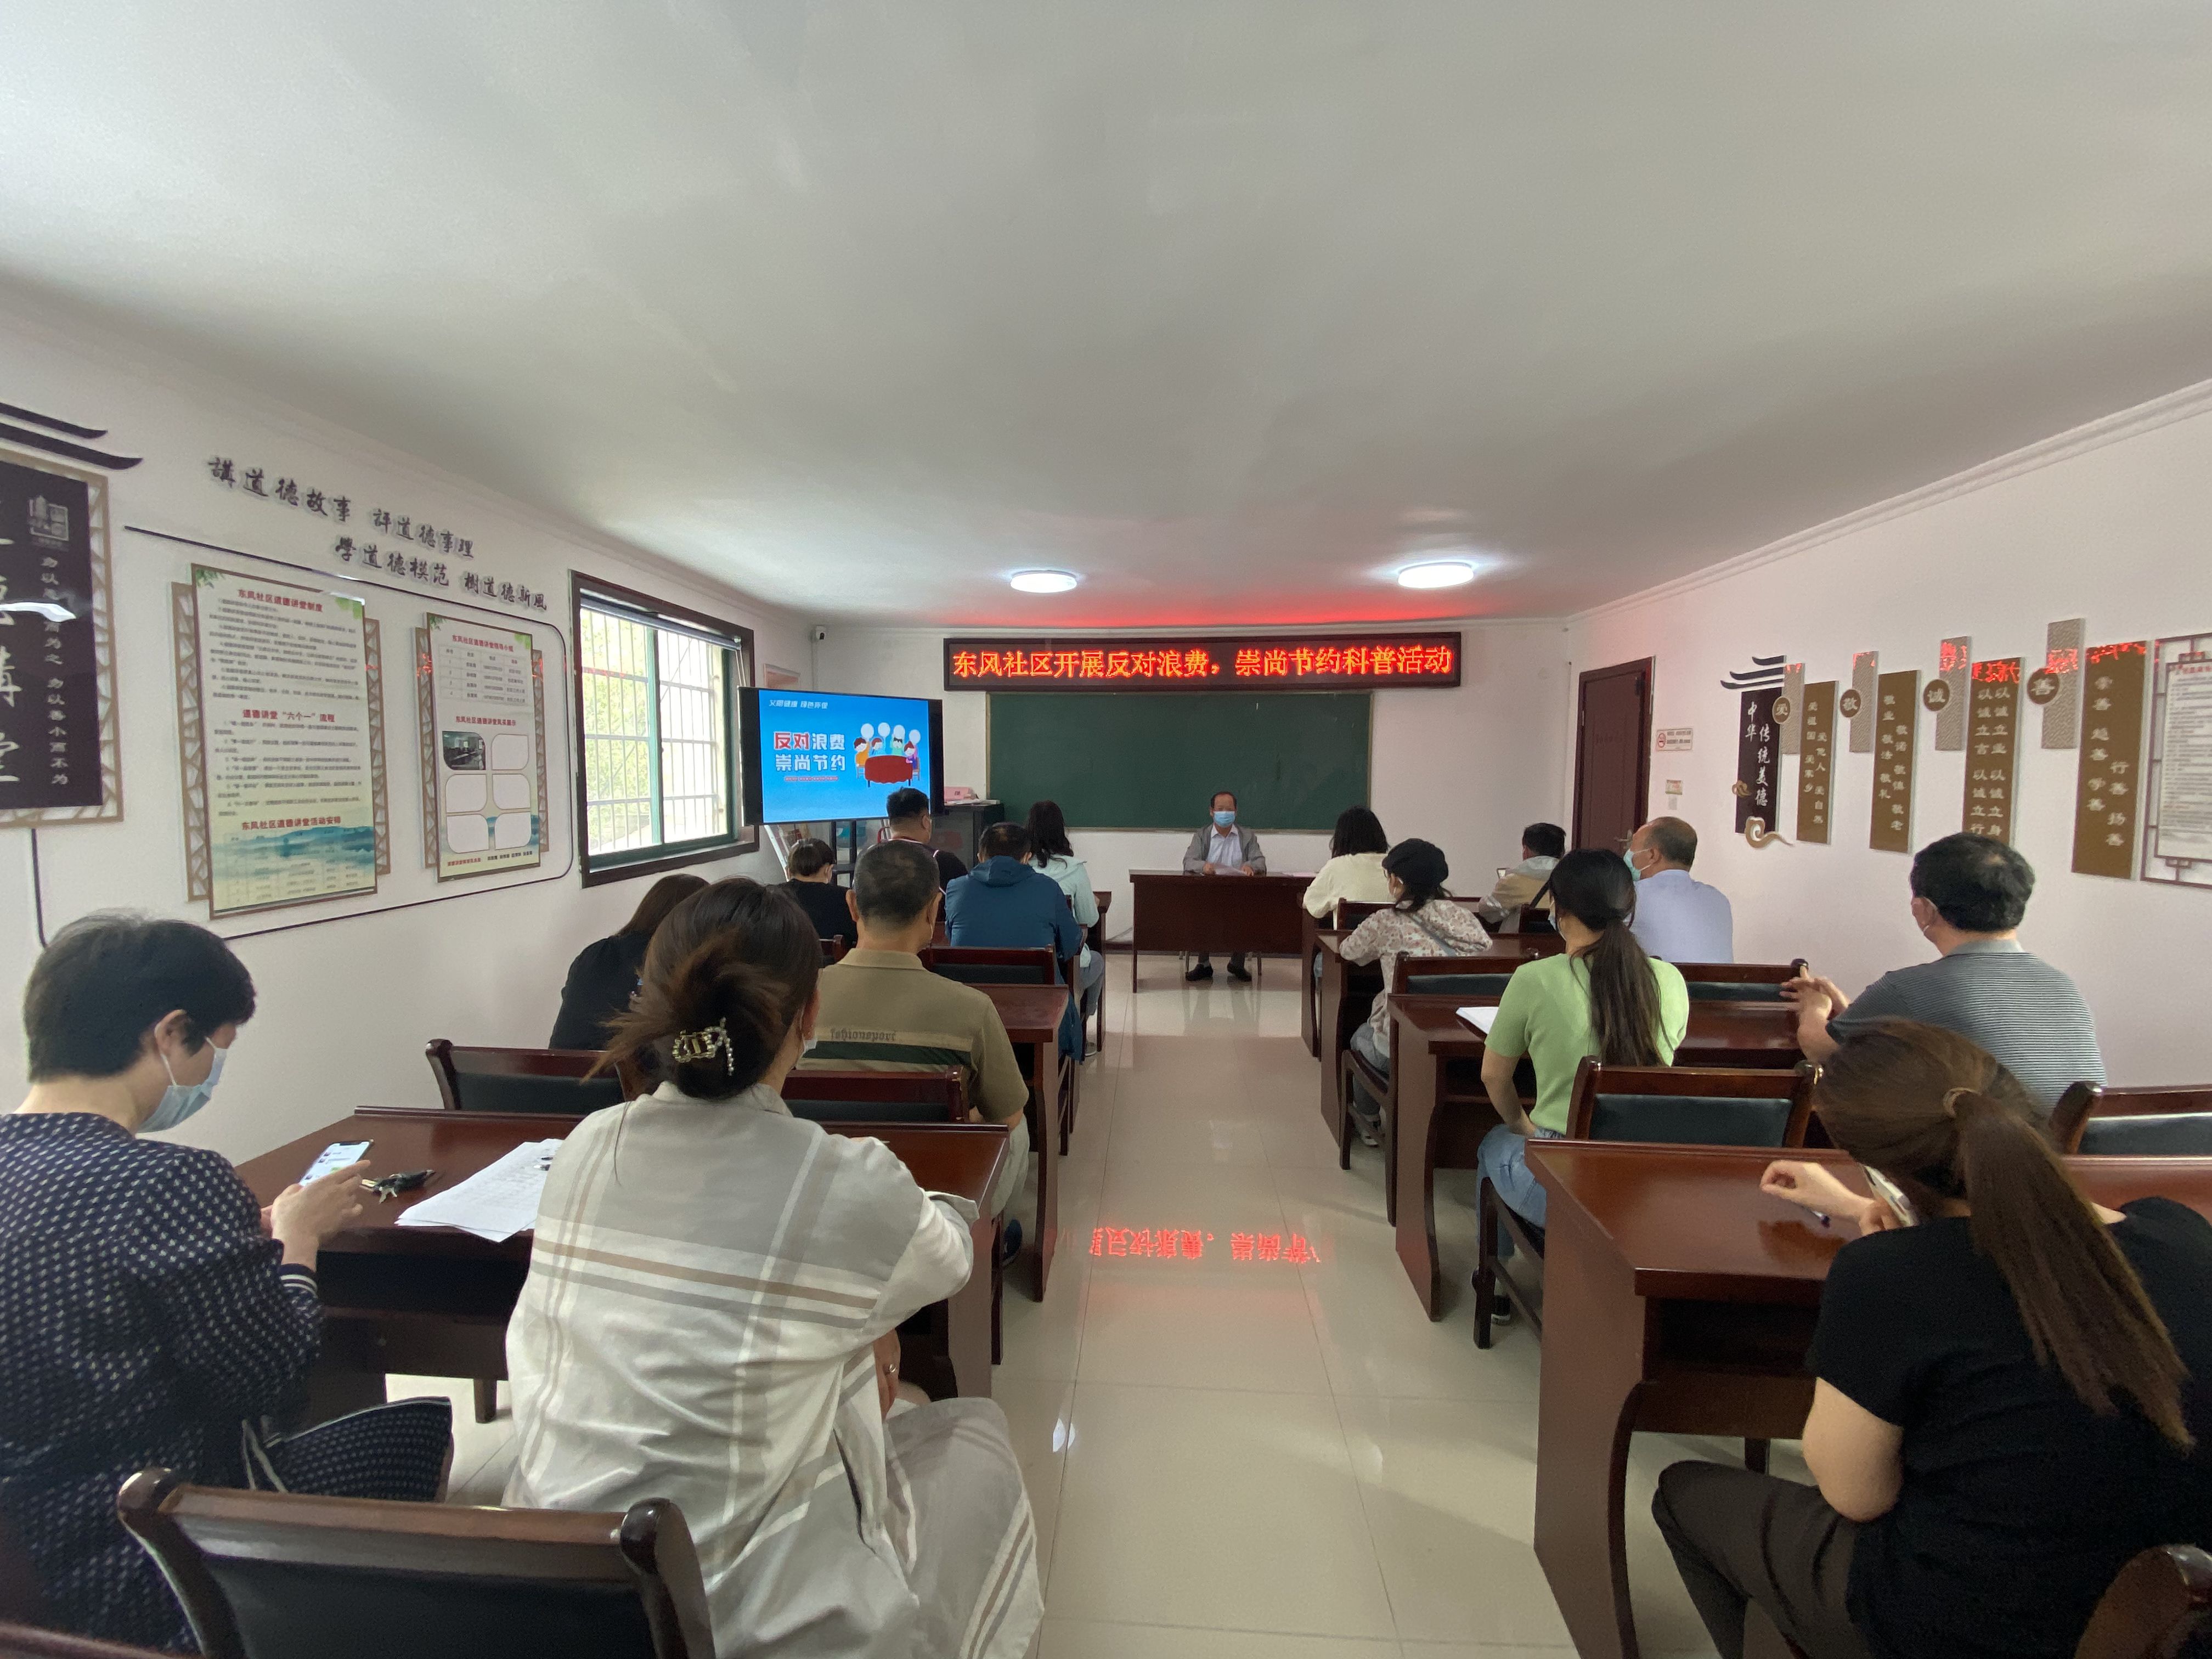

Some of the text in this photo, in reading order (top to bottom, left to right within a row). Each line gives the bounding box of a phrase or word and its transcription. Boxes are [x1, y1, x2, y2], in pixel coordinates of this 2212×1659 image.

[1745, 701, 1758, 742] 中华
[774, 731, 845, 751] 反对浪费
[775, 754, 846, 771] 崇尚节约
[1755, 723, 1771, 807] 传统美德
